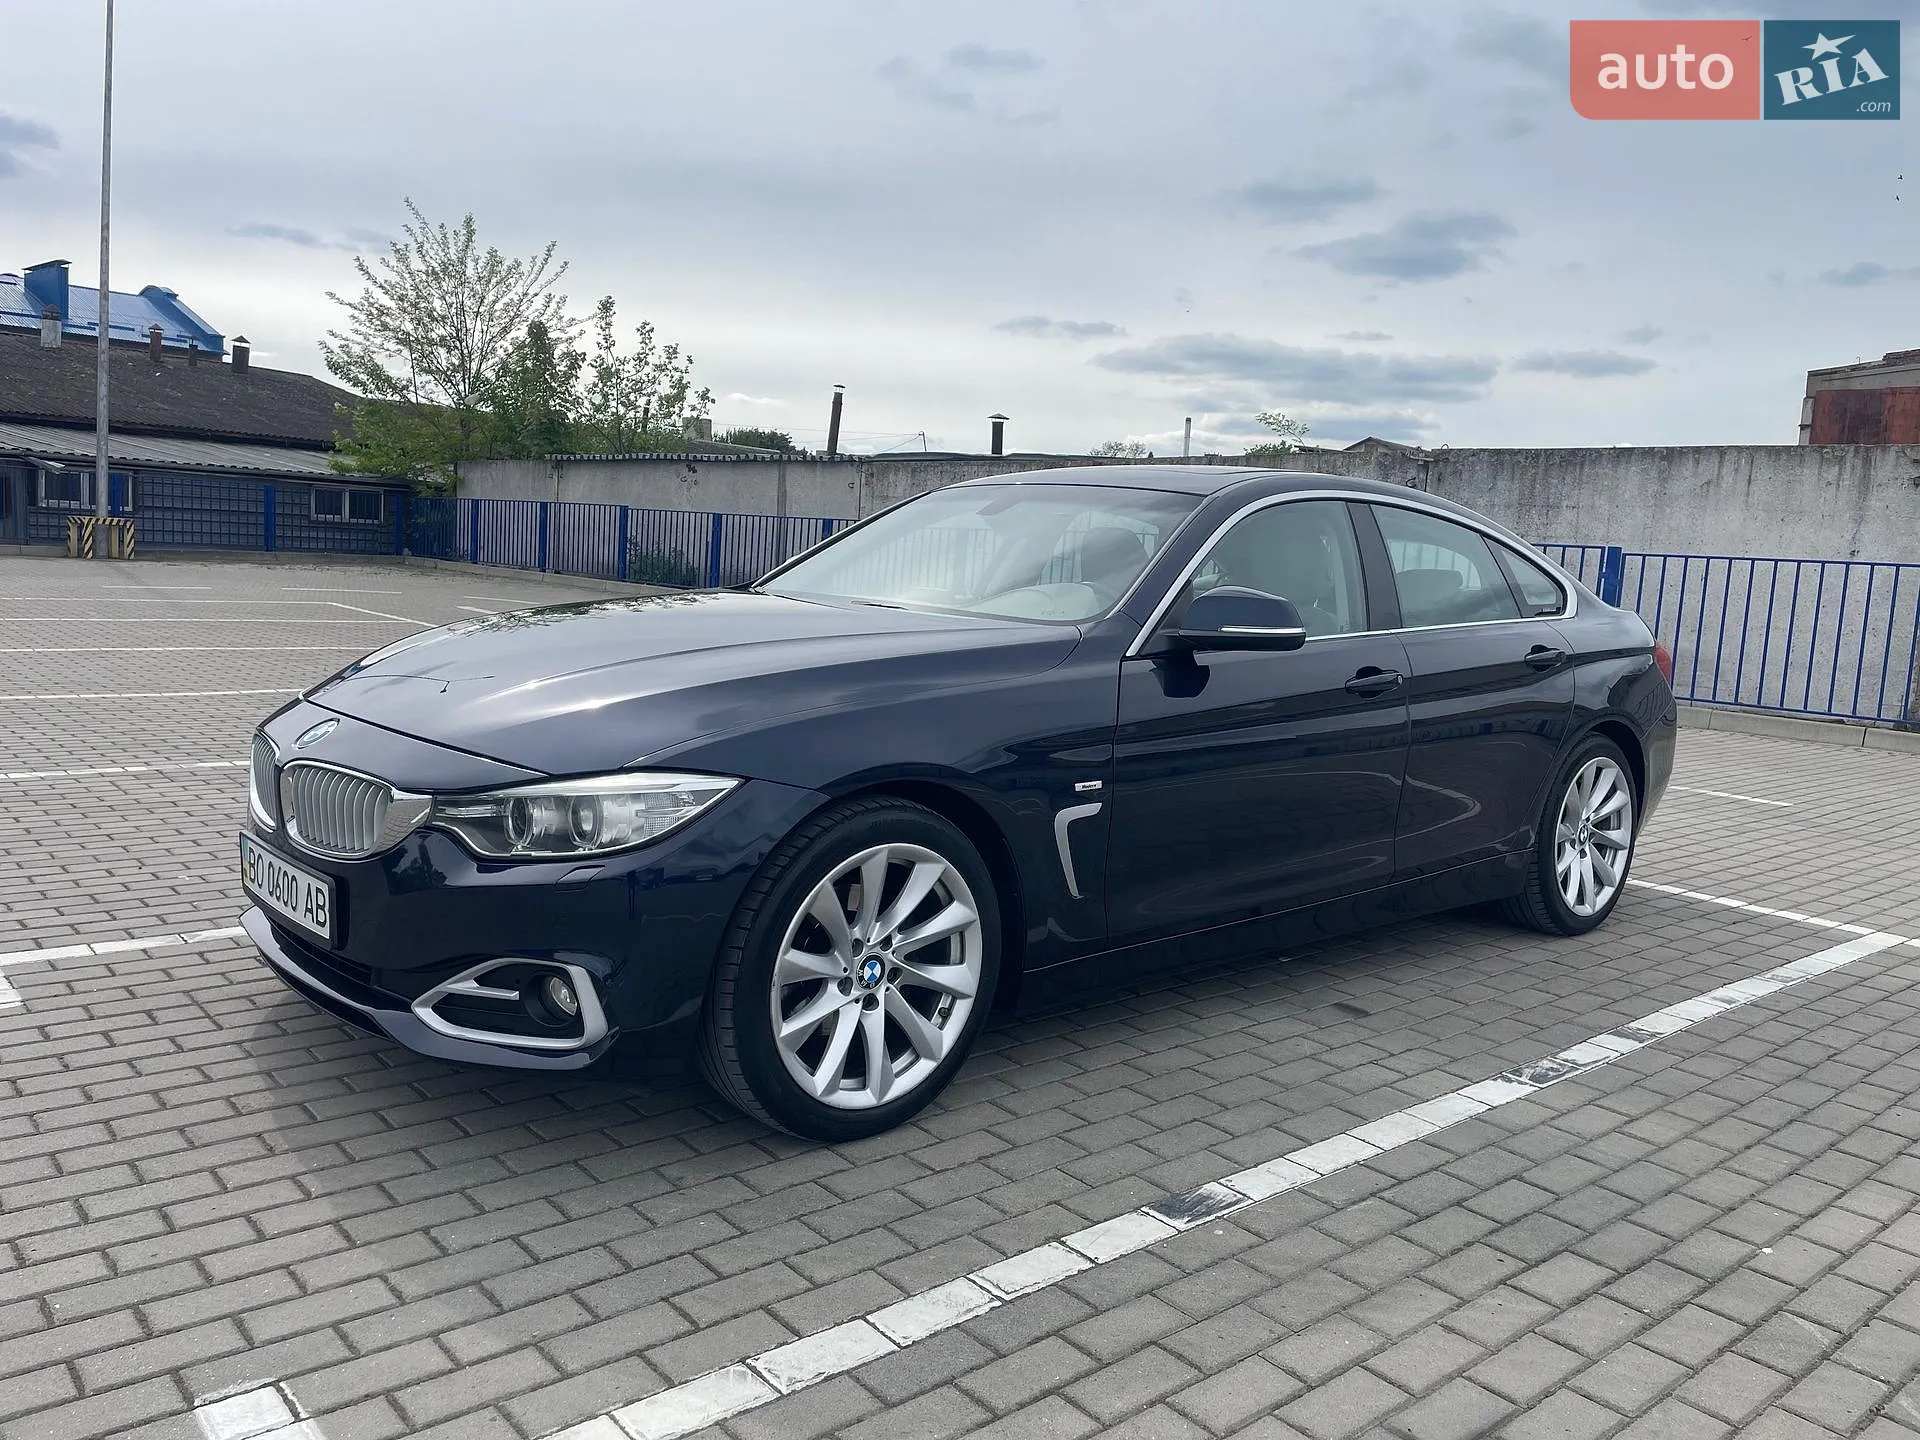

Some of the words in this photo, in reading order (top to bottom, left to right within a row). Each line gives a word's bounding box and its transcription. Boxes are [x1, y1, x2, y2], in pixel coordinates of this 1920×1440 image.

[248, 846, 264, 889] BO
[267, 860, 298, 912] 0600
[303, 882, 327, 928] AB
